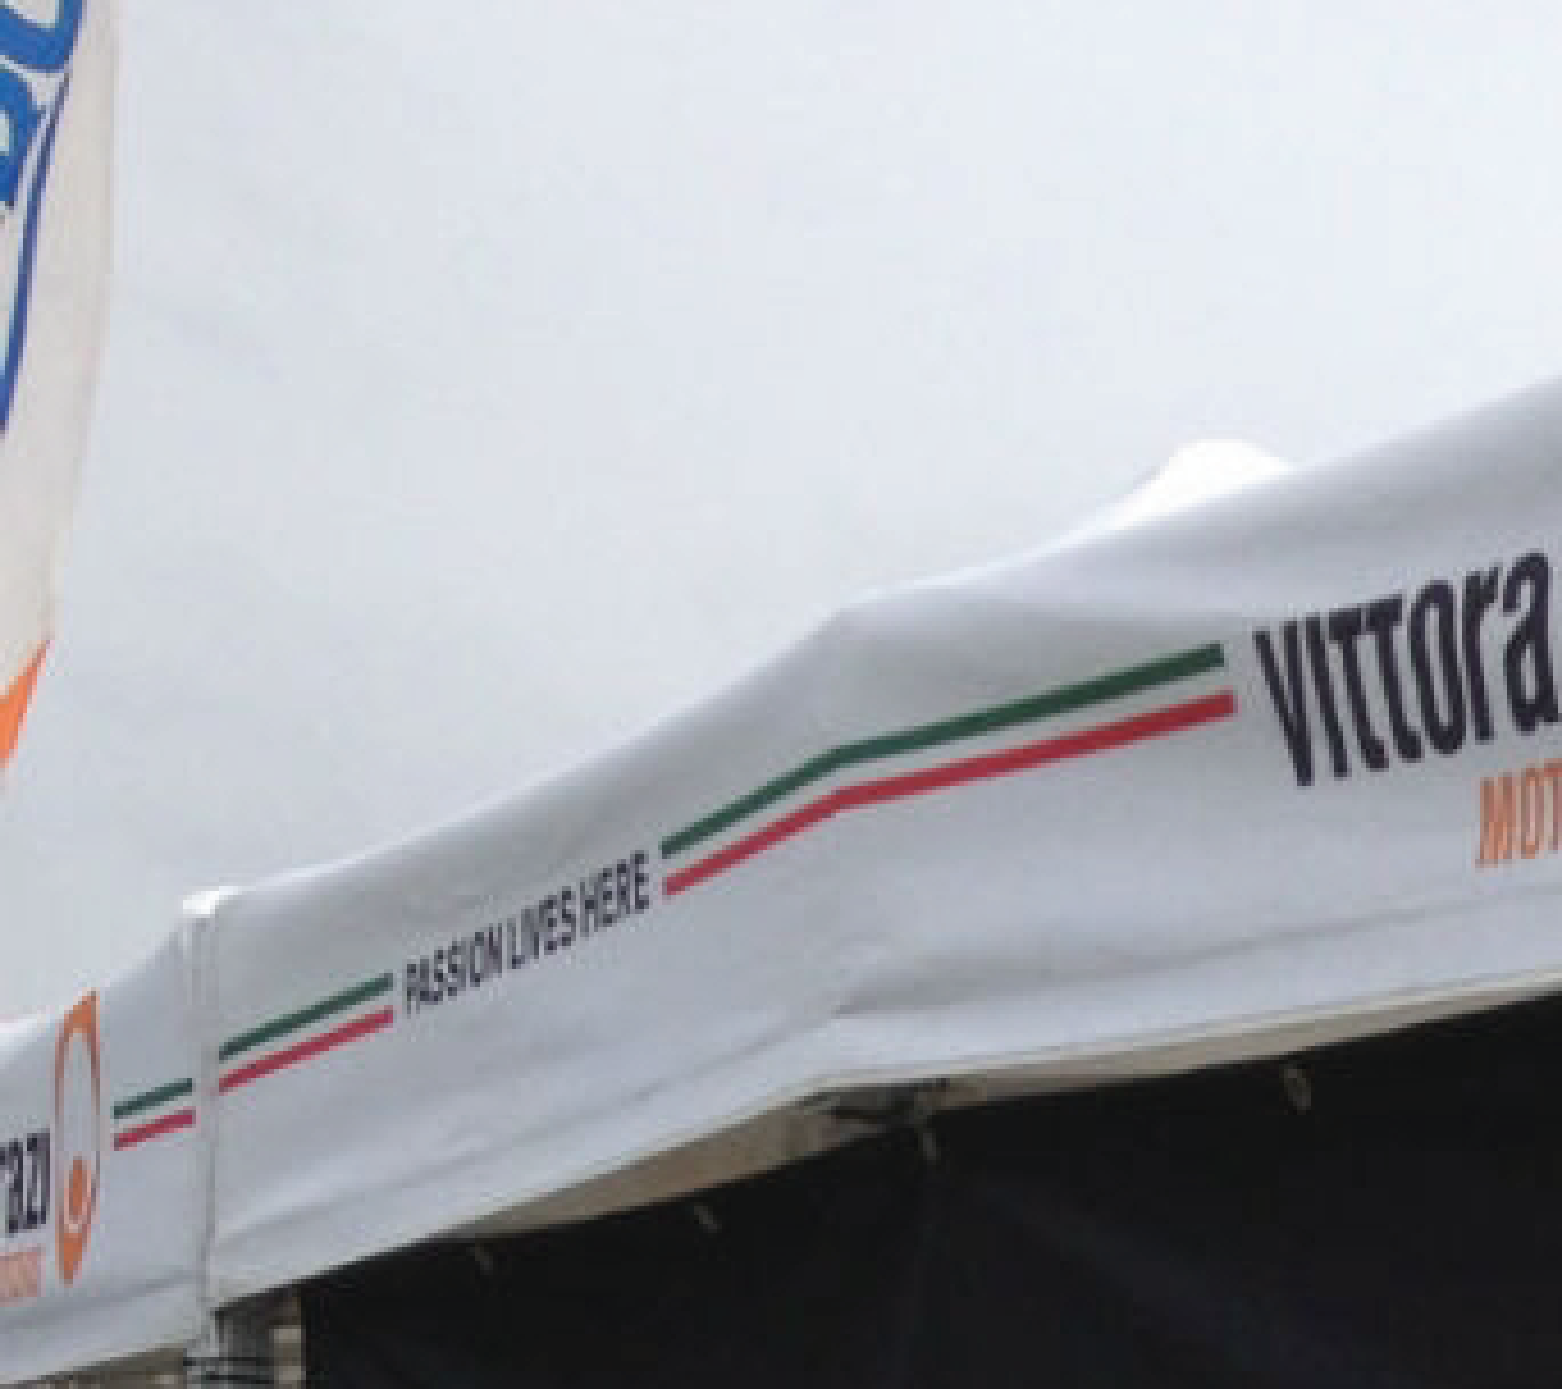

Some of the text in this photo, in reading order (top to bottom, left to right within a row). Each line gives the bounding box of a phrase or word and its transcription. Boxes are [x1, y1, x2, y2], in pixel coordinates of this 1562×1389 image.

[402, 849, 650, 1018] PASSION LIVES HERE
